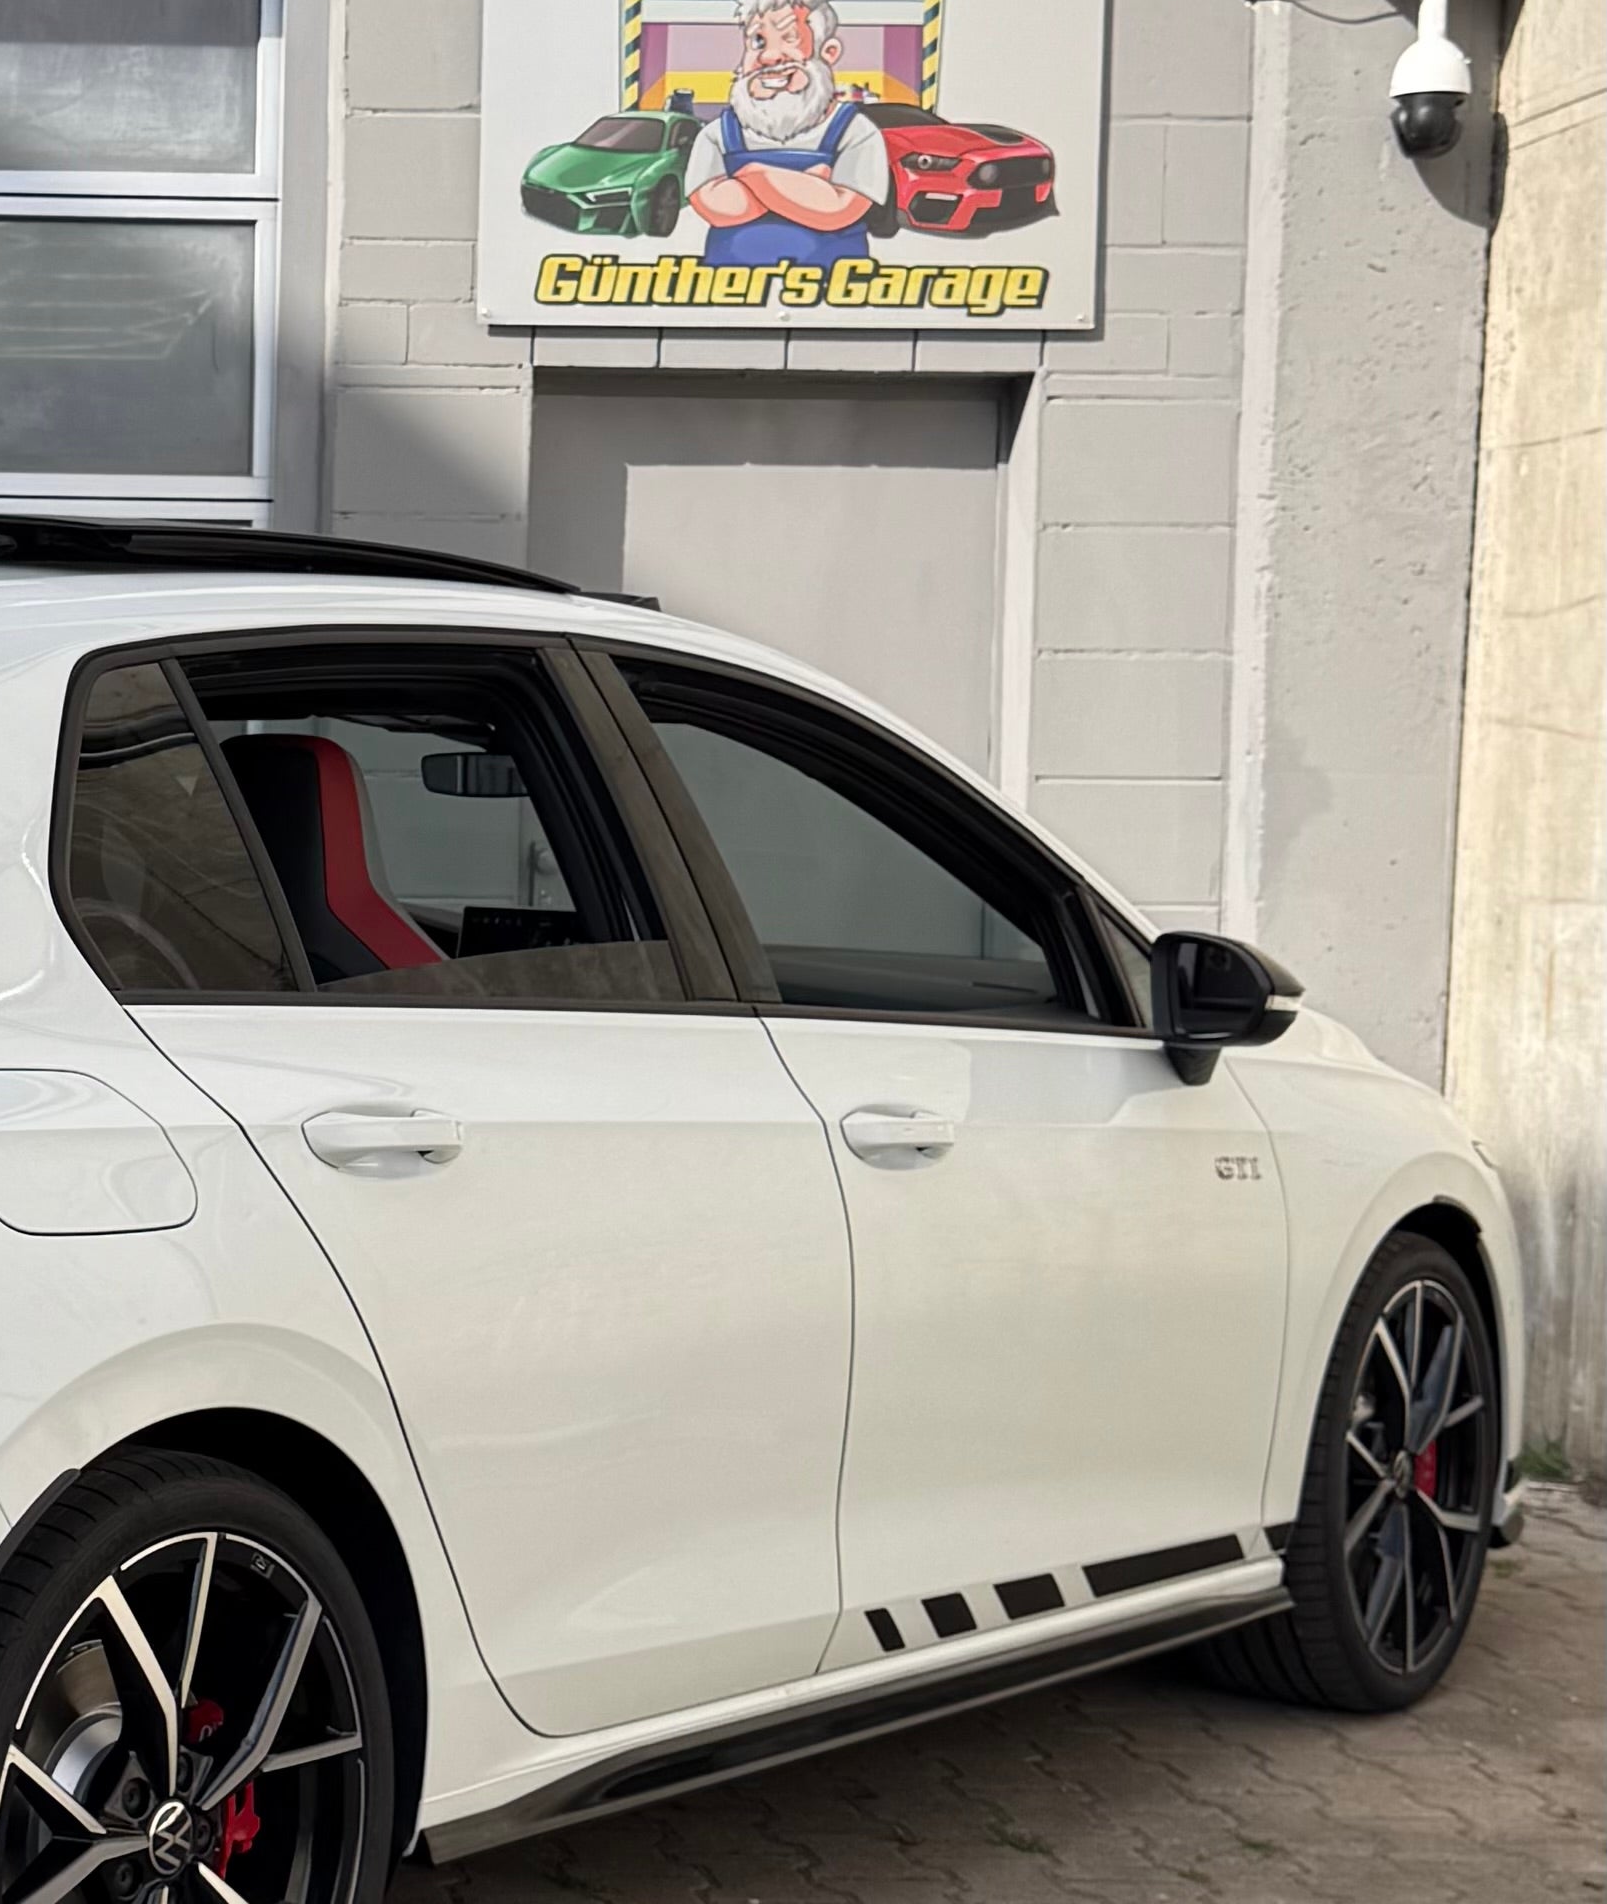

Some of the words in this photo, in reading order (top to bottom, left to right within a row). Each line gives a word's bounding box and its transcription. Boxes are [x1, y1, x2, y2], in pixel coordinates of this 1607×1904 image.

[533, 254, 825, 308] Günther's
[825, 257, 1047, 317] Garage
[1214, 1156, 1262, 1181] GTI
